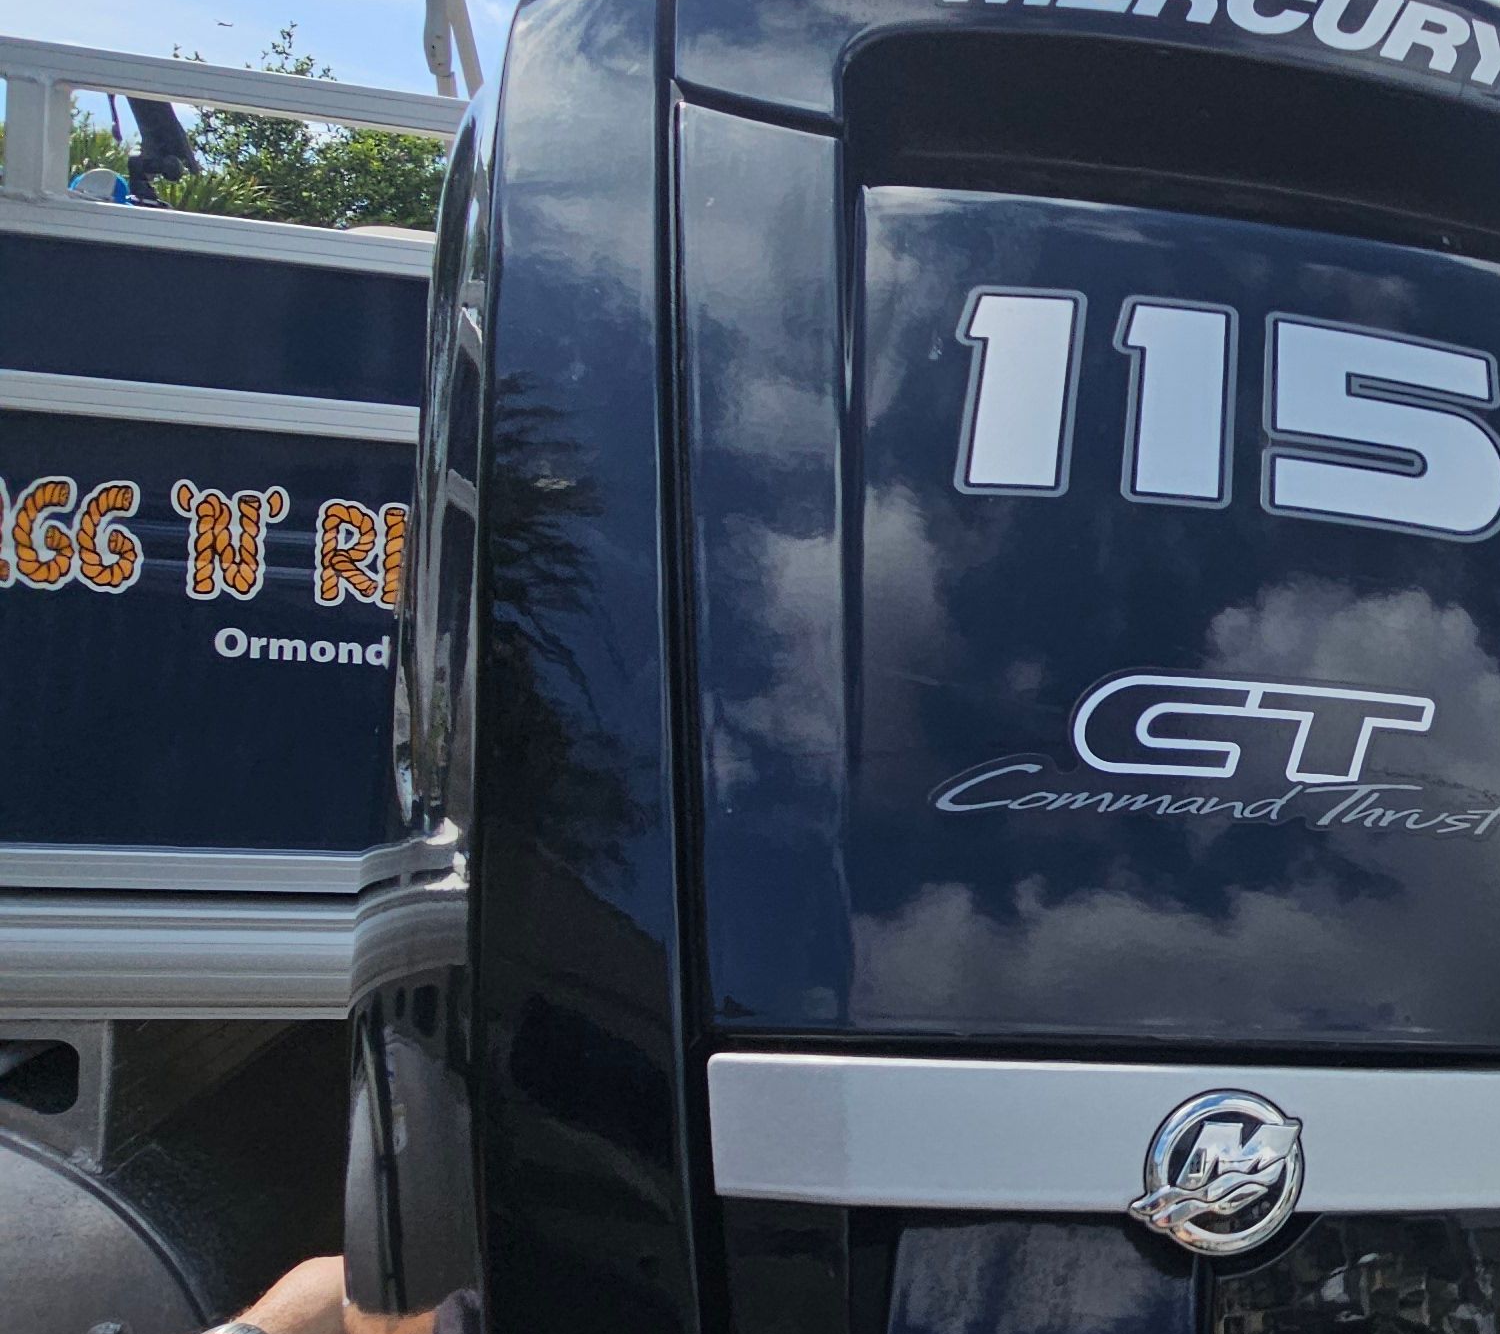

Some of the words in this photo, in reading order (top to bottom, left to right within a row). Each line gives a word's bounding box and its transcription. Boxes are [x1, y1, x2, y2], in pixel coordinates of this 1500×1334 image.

[0, 476, 143, 593] GG
[214, 627, 391, 669] Ormond
[935, 763, 1304, 820] Command
